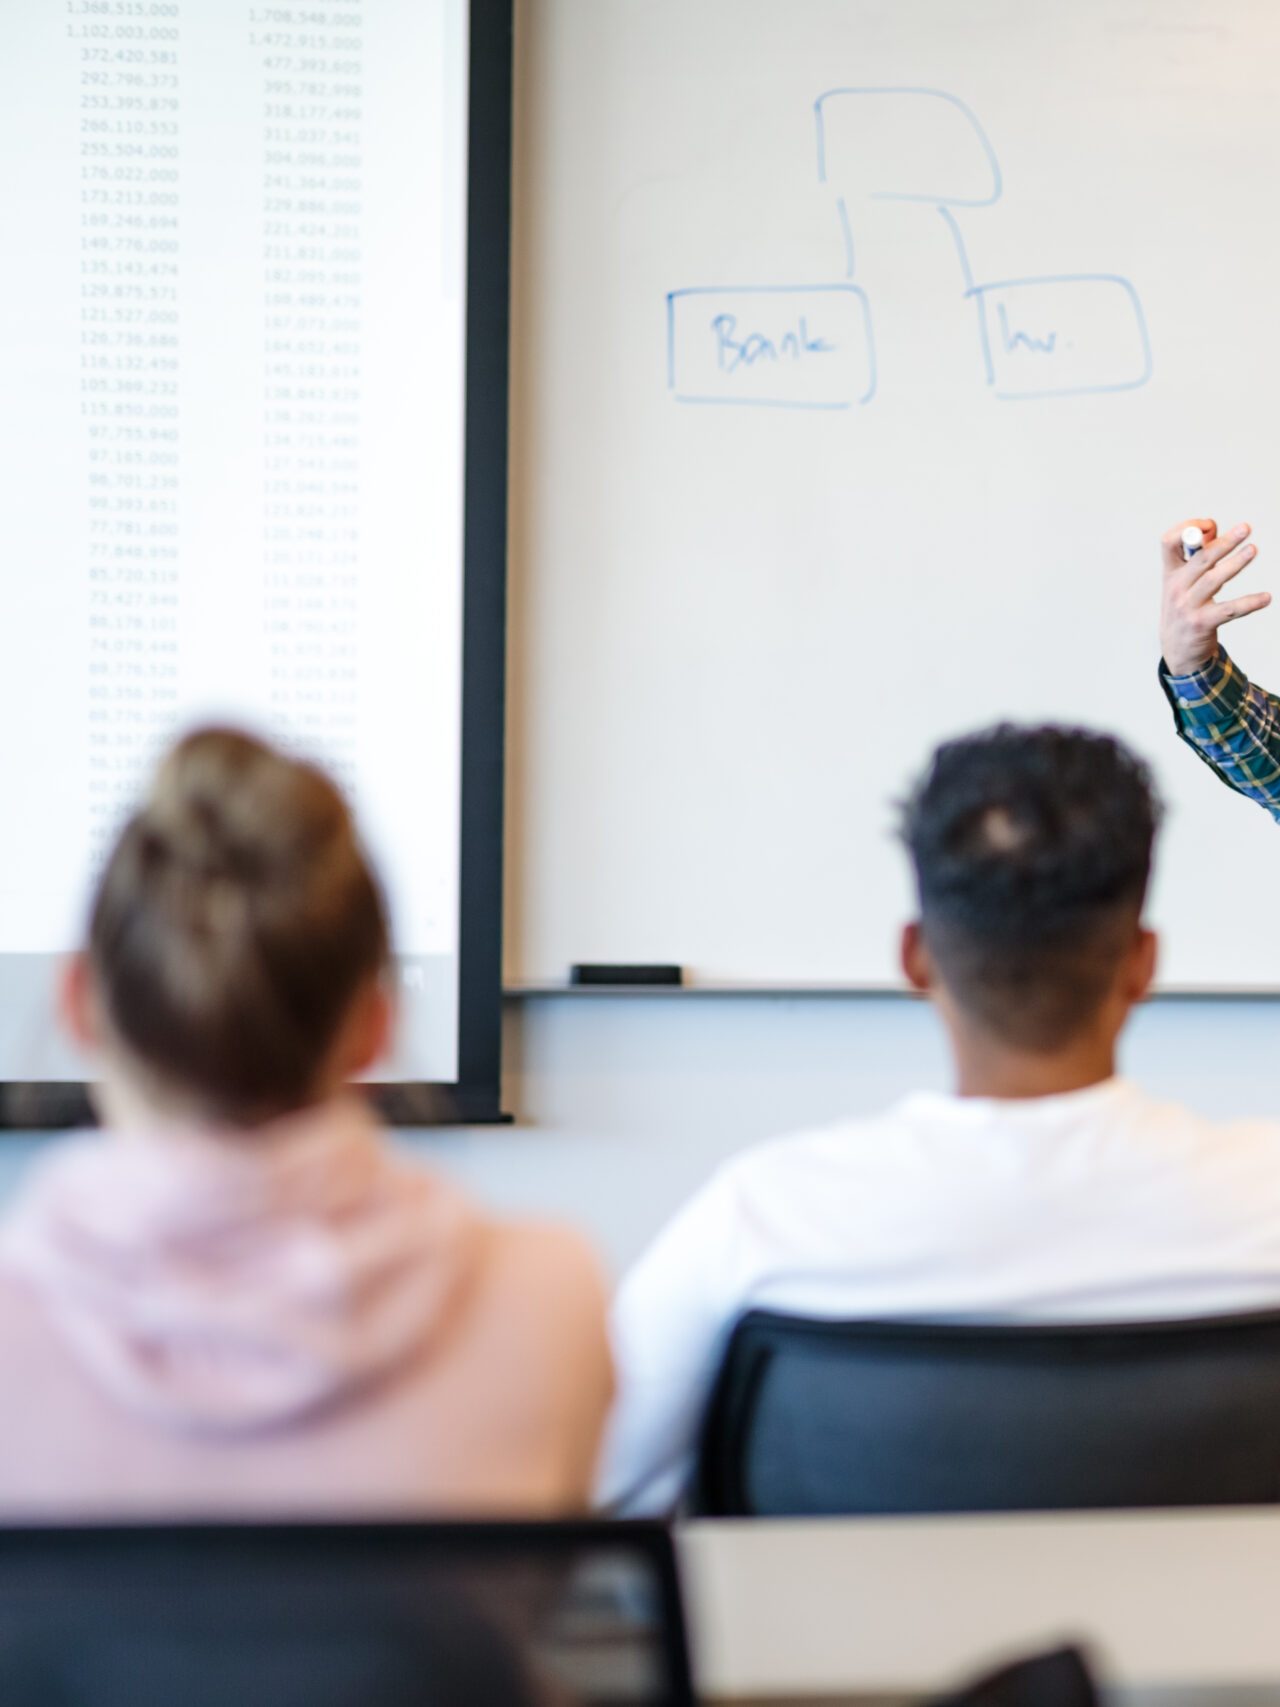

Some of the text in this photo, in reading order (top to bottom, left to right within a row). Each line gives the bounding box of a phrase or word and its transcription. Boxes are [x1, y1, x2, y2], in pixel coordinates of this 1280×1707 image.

[67, 23, 179, 41] 1,102,003,000
[82, 48, 177, 64] 372,420,581
[81, 71, 179, 88] 292,796,373
[81, 142, 179, 159] 255,504,000
[82, 166, 179, 183] 176,022,000
[82, 189, 179, 206] 173,213,000
[711, 313, 836, 375] Bank
